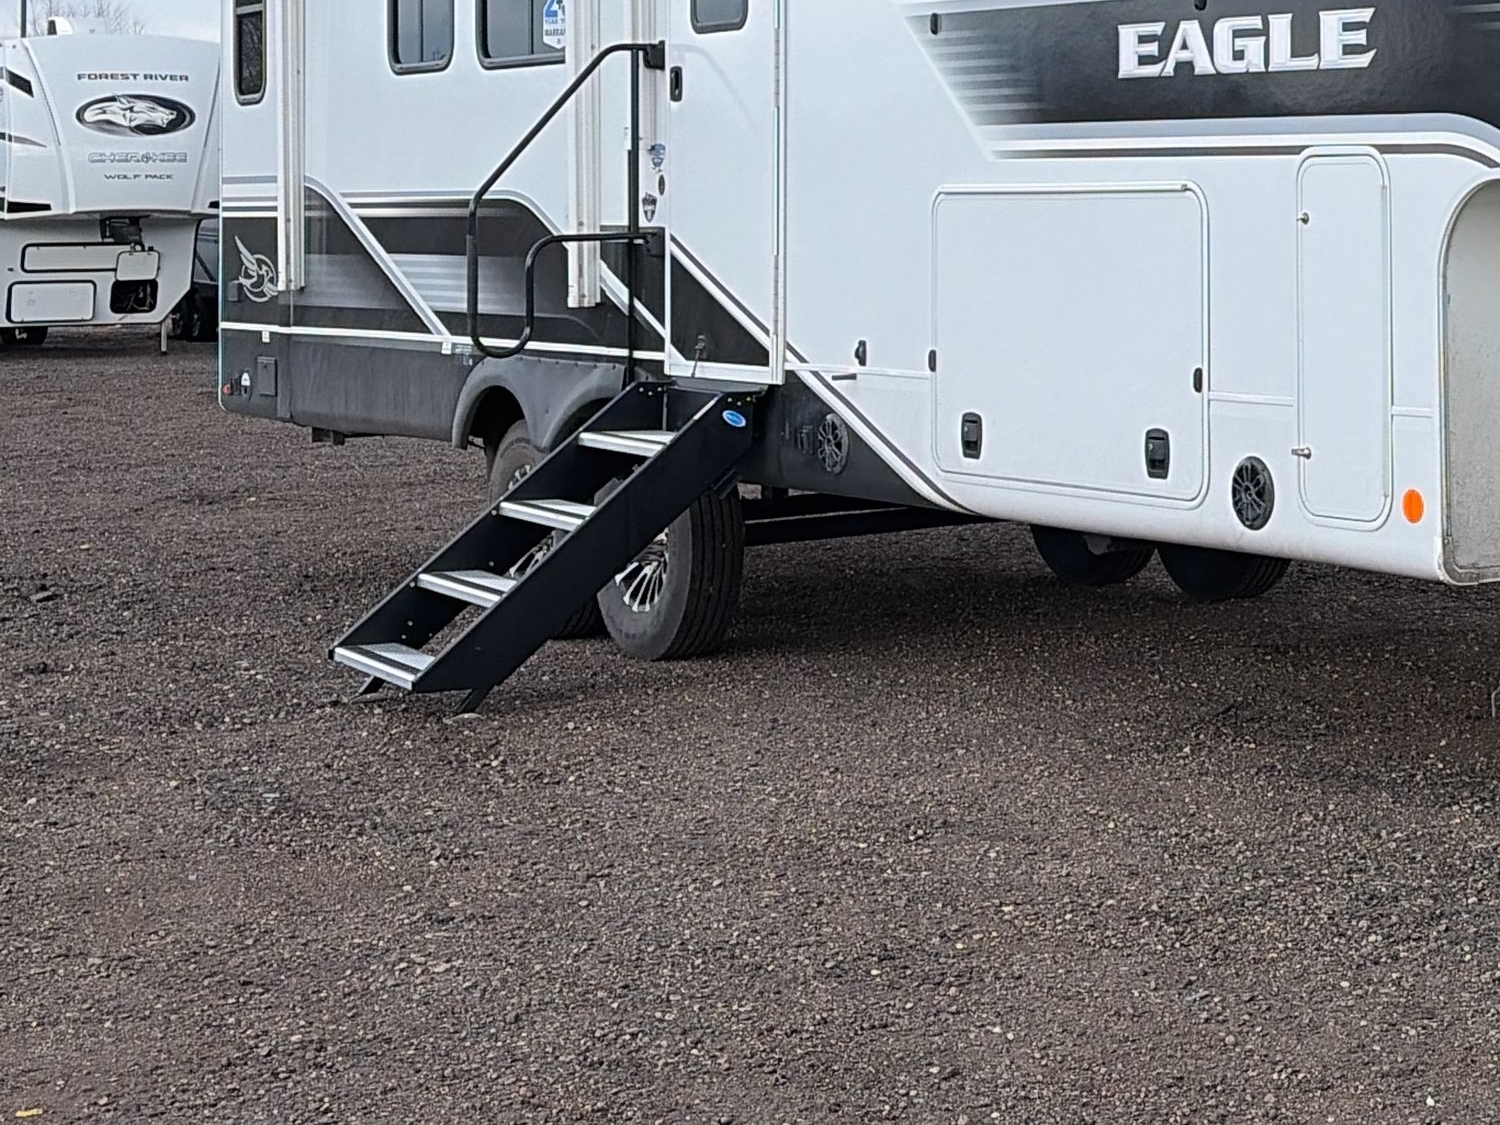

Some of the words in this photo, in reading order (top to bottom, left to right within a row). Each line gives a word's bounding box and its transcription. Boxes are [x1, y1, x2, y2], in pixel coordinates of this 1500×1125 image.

[1117, 7, 1378, 79] EAGLE
[77, 73, 140, 81] FOREST
[143, 73, 189, 82] RIVER
[88, 152, 188, 163] CHEROKEE
